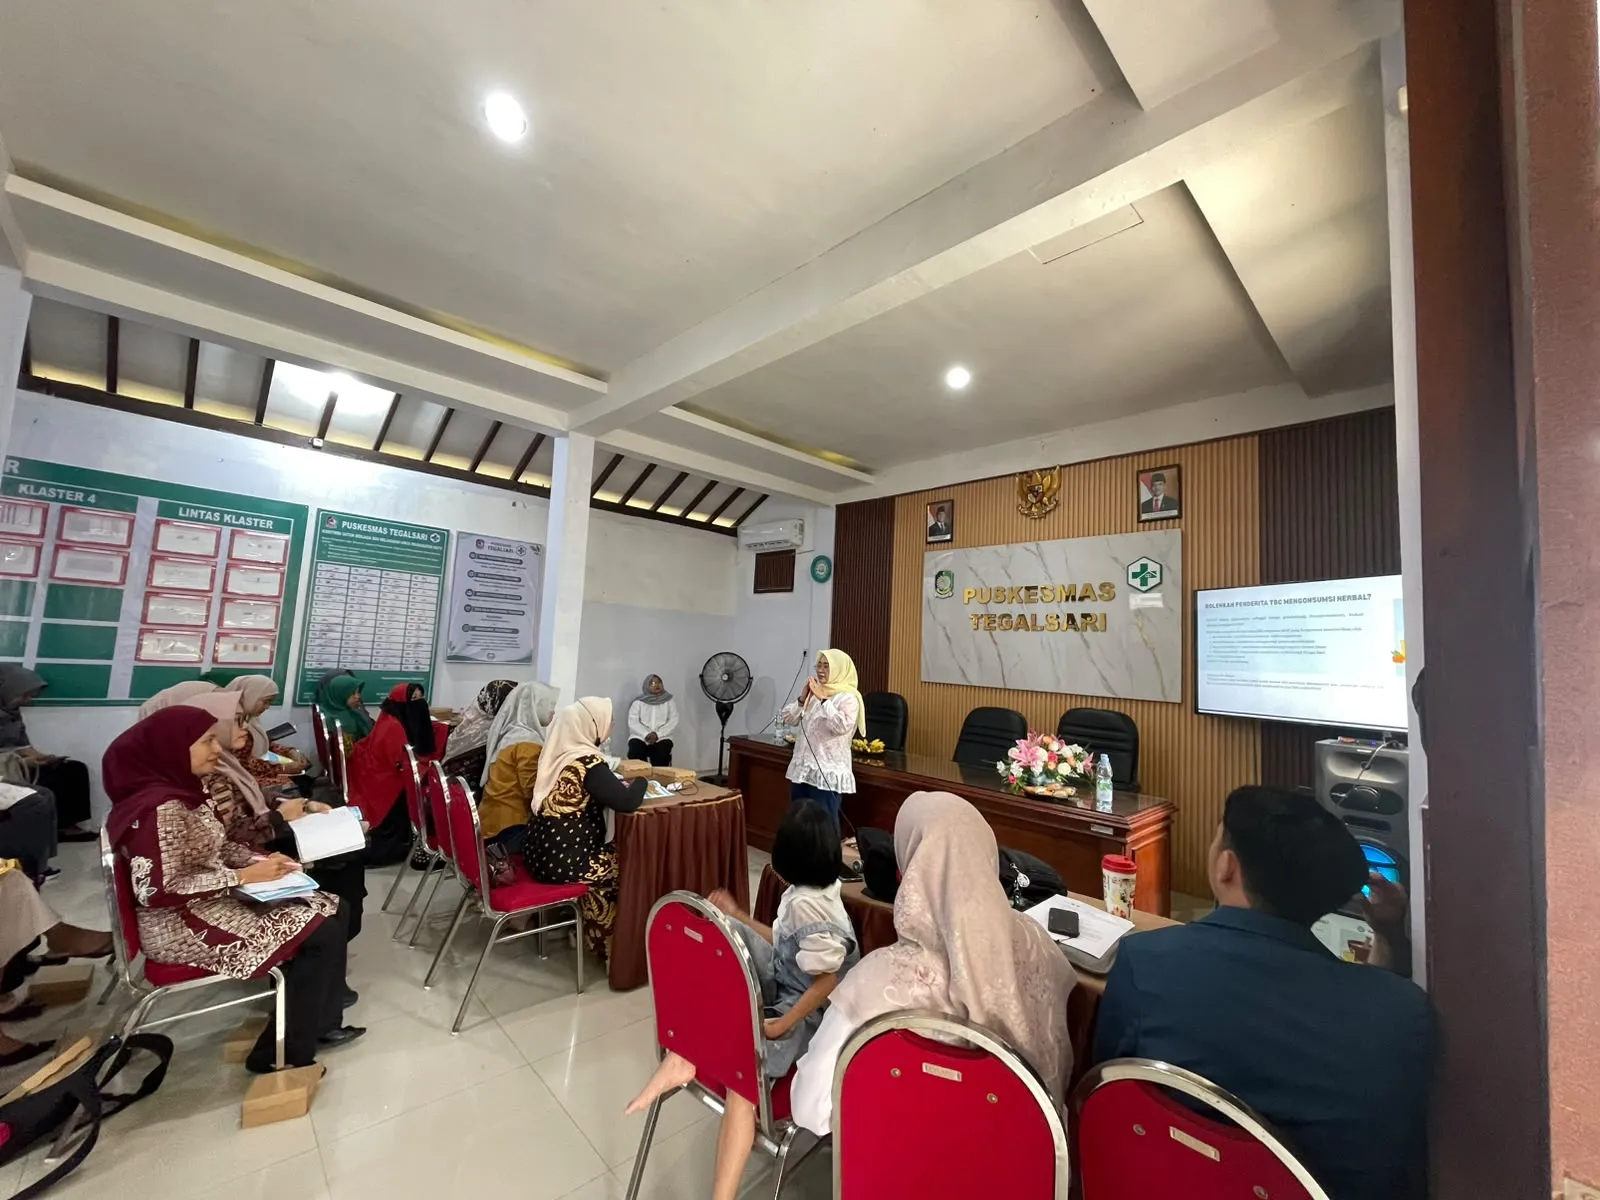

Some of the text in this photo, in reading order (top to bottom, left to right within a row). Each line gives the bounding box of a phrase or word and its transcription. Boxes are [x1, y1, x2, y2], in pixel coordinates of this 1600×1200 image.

[18, 483, 96, 504] KLASTER 4
[178, 506, 273, 529] LINTAS KLASTER
[341, 520, 388, 535] PUSKESMAS
[389, 528, 429, 541] TEGALSARI
[963, 581, 1116, 605] PUSKESMAS
[1235, 599, 1269, 608] PENDERITA
[1270, 598, 1283, 606] TBC
[1283, 595, 1336, 605] MENGONSUMSI
[1336, 593, 1372, 603] HERBAL?
[968, 612, 1108, 633] TEGALSARI
